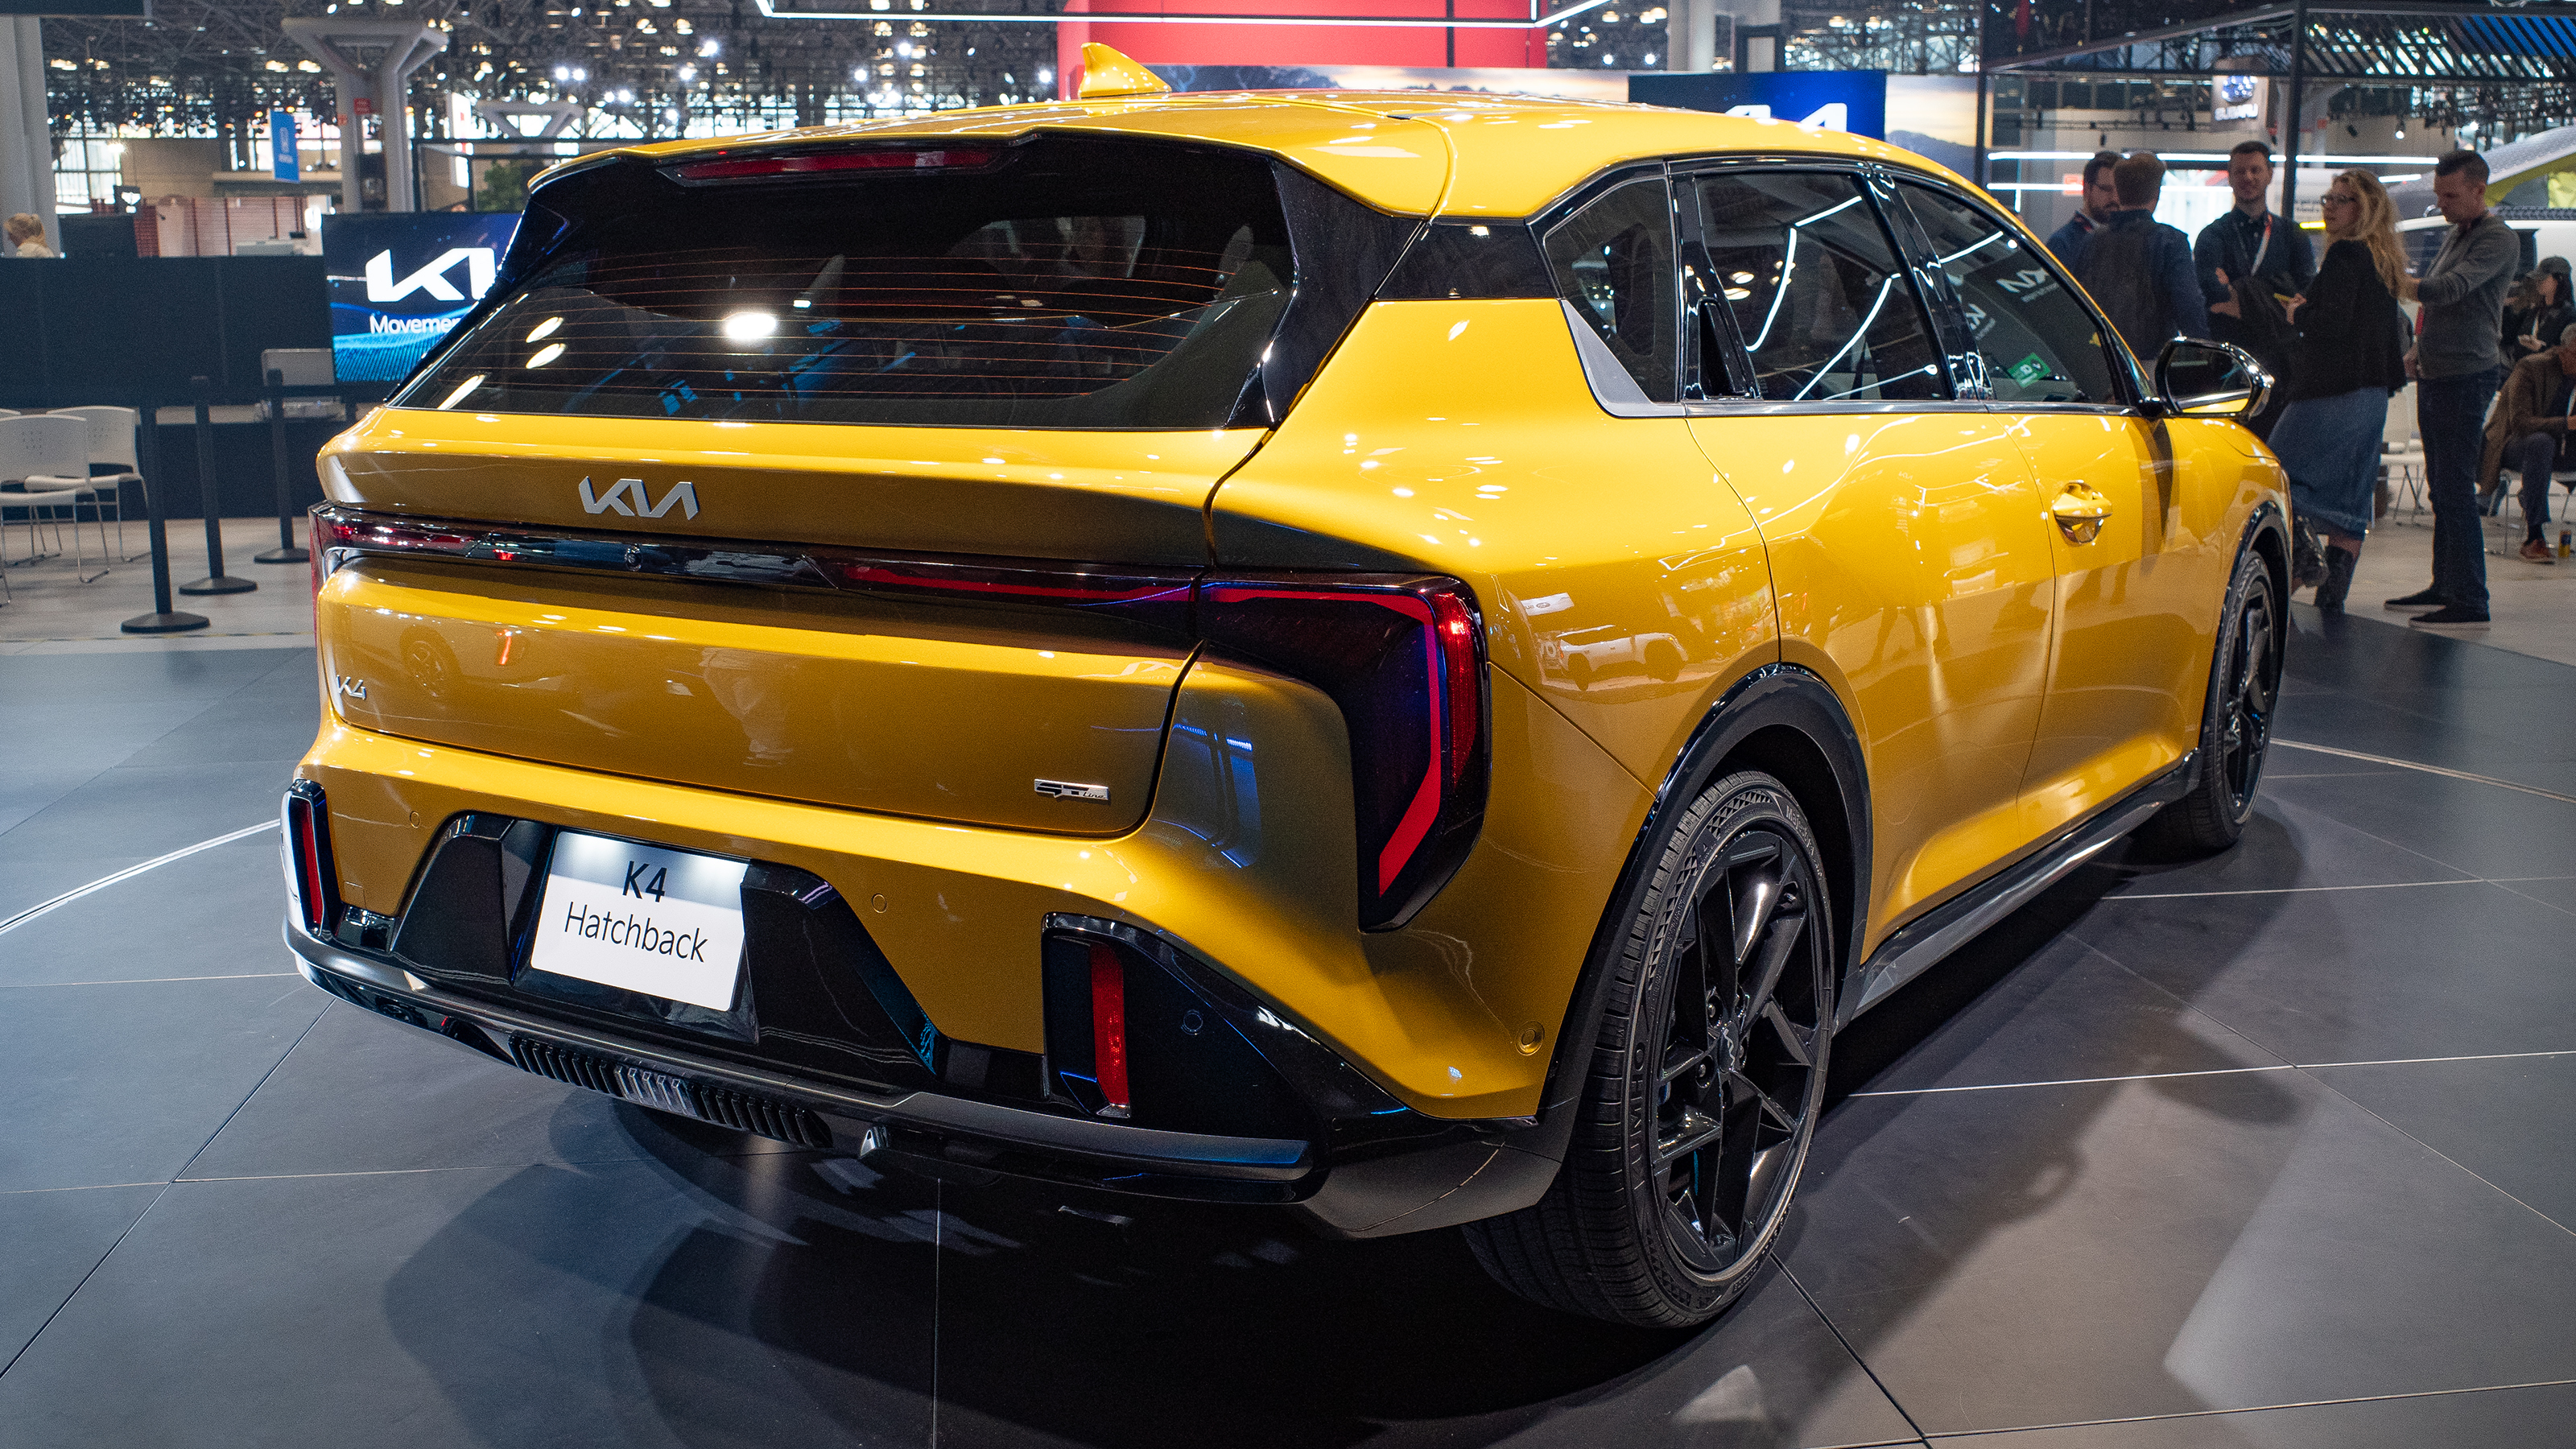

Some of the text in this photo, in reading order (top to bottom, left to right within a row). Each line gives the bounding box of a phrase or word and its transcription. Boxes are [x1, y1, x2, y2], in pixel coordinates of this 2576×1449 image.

[365, 247, 497, 303] KI
[578, 476, 700, 521] KIA
[336, 674, 367, 700] K4
[621, 860, 667, 903] K4
[564, 901, 708, 964] Hatchback
